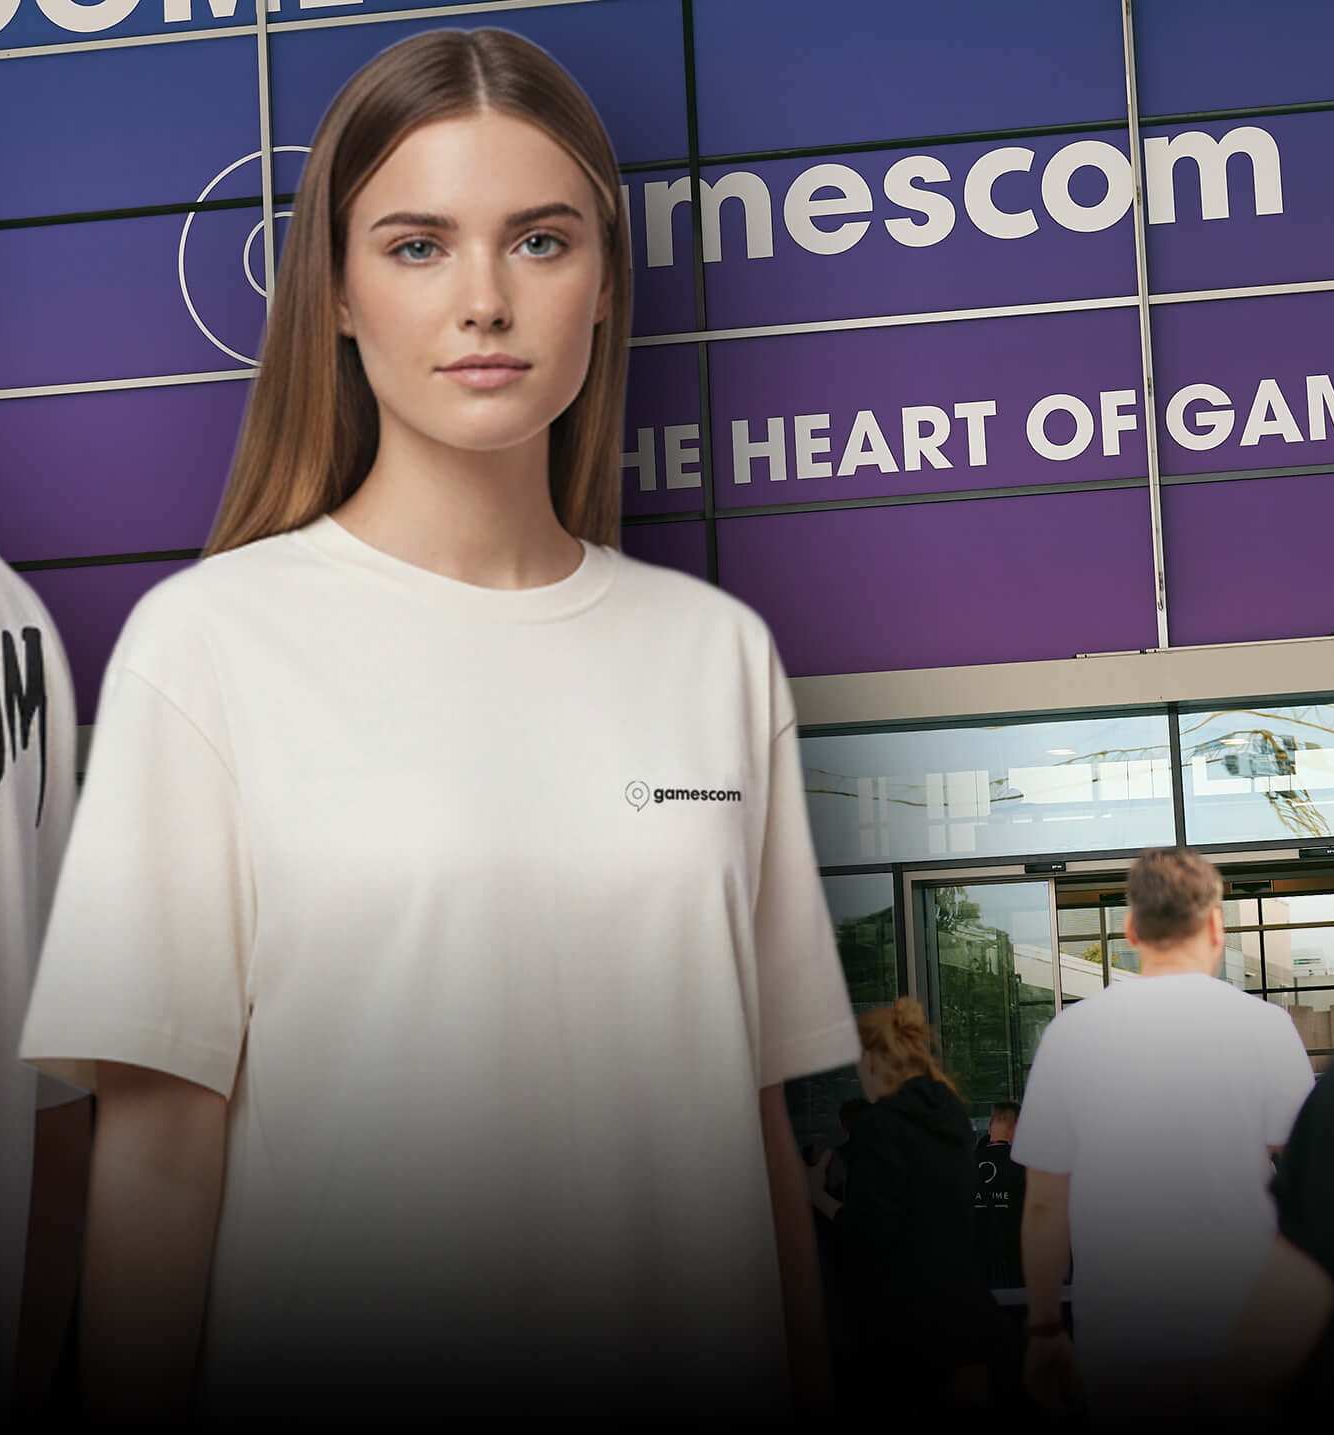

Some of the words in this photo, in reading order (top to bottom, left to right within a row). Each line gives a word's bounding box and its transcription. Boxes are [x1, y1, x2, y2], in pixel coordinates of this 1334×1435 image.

[620, 125, 1284, 268] mescom
[730, 400, 996, 485] HEART
[1026, 390, 1138, 463] OF
[653, 788, 742, 804] gamescom
